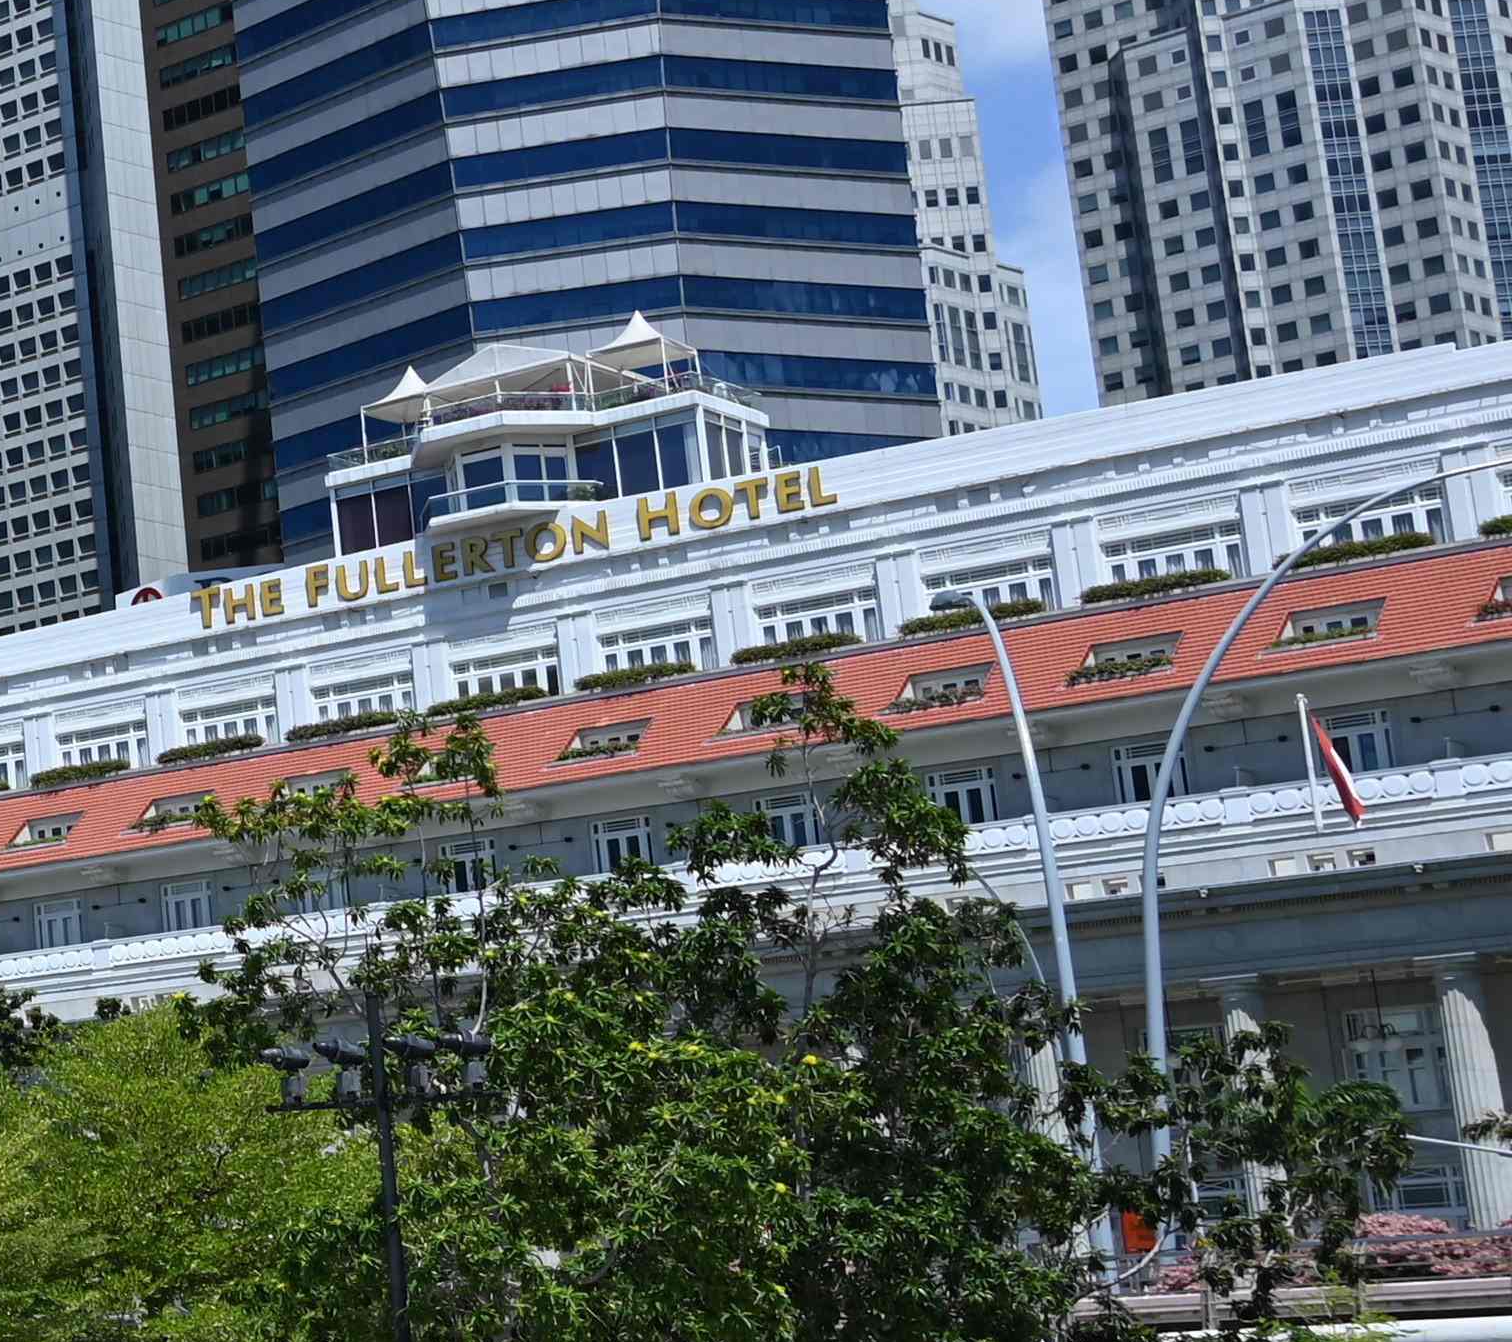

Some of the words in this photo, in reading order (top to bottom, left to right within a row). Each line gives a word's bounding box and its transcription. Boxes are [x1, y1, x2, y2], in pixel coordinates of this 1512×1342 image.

[191, 577, 285, 630] THE
[305, 509, 610, 607] FULLERTON
[636, 466, 840, 541] HOTEL
